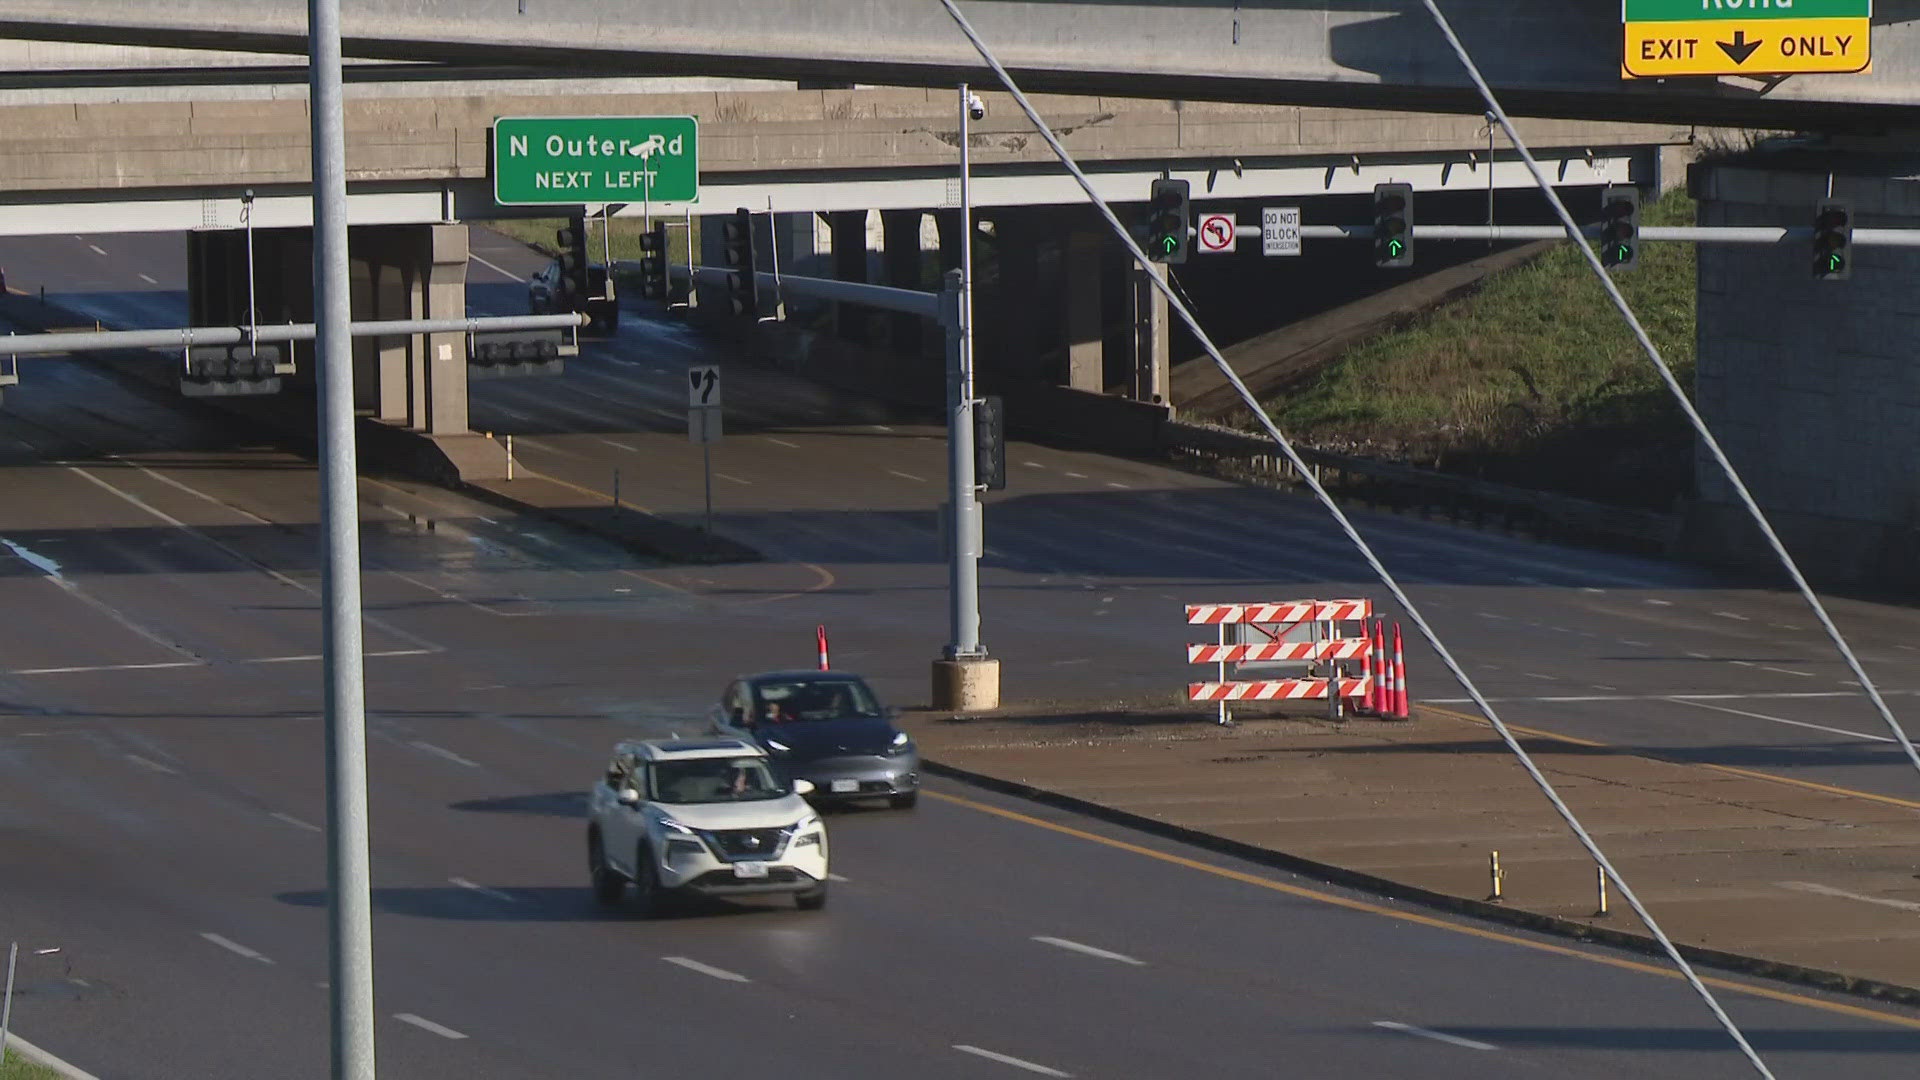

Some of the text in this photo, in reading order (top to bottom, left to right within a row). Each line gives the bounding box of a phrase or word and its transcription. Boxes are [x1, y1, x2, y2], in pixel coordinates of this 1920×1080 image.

[1641, 35, 1852, 60] EXIT ONLY
[510, 134, 682, 157] N Outer Rd
[536, 171, 658, 189] NEXT LEFT
[1265, 213, 1297, 224] DO NOT
[1265, 228, 1298, 240] BLOCK
